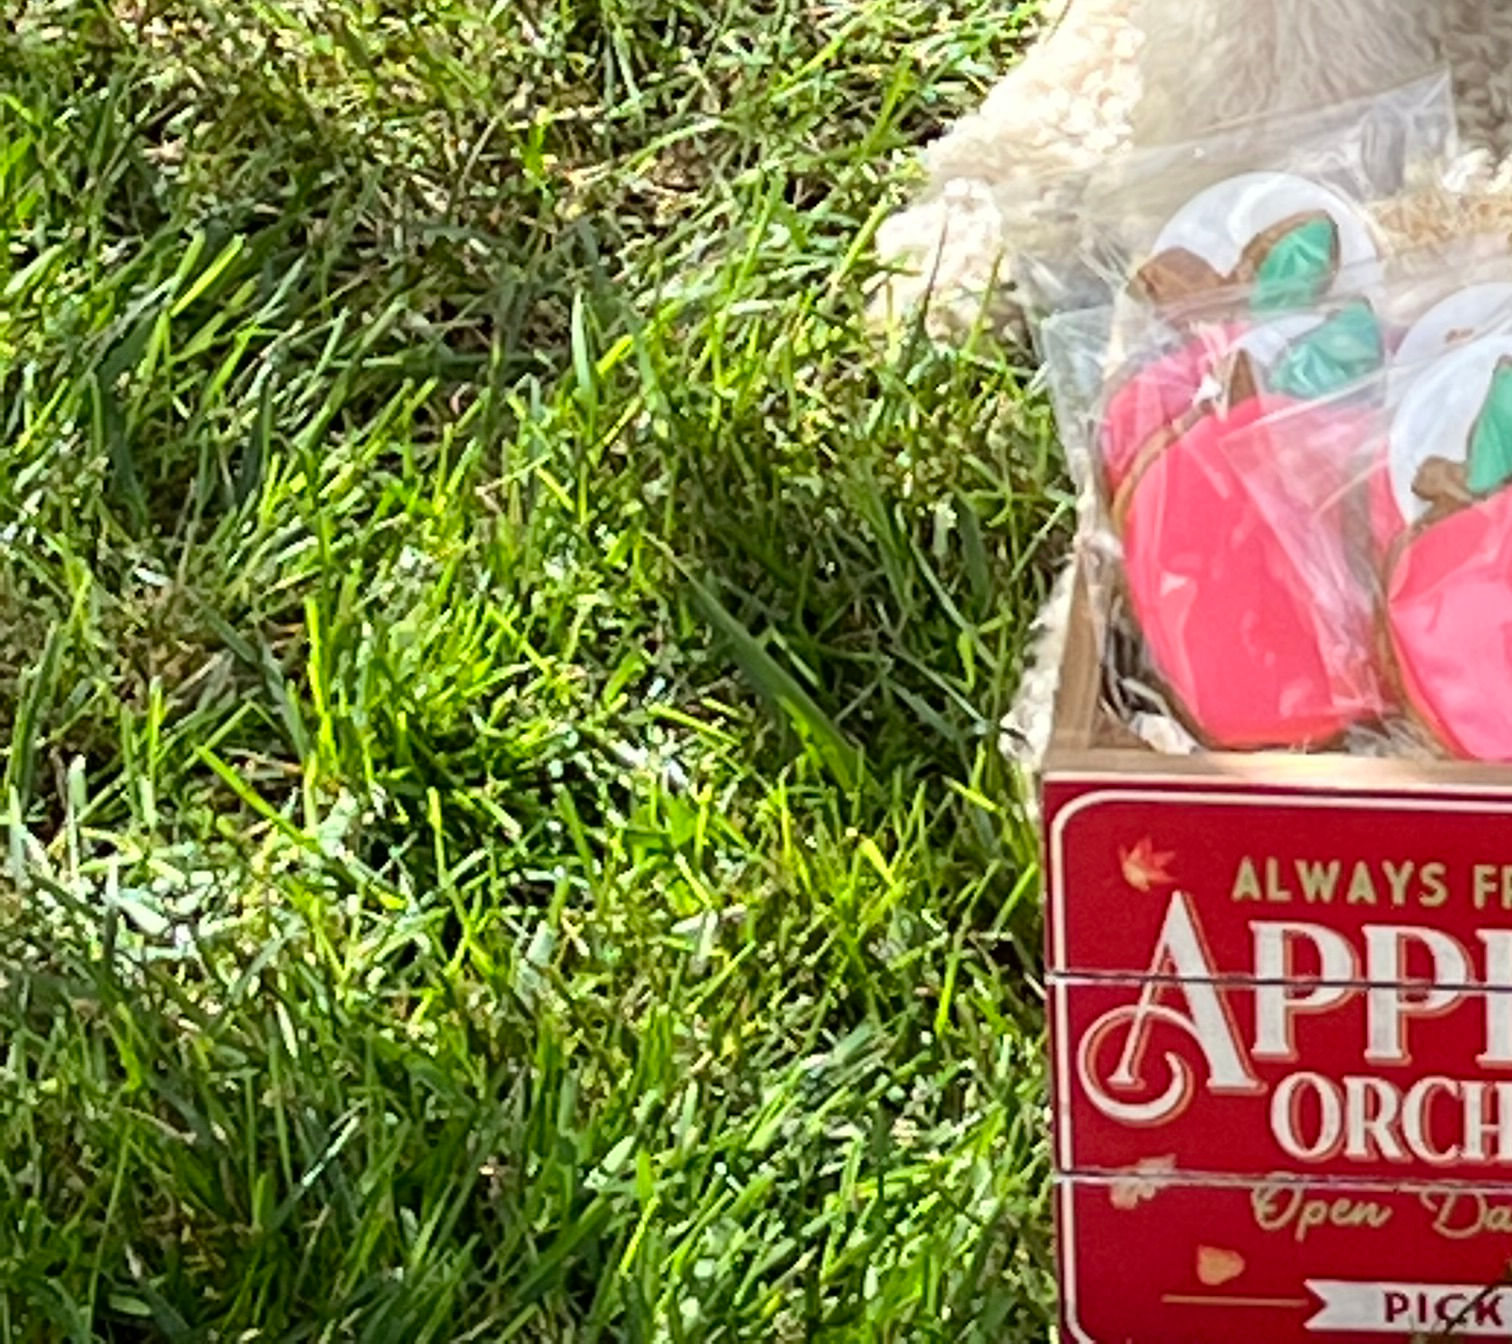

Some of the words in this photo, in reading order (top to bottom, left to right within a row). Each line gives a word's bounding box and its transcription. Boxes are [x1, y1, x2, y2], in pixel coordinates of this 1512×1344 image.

[1232, 857, 1448, 907] ALWAYS
[1250, 1172, 1392, 1242] Open
[1384, 1291, 1502, 1328] PICK
